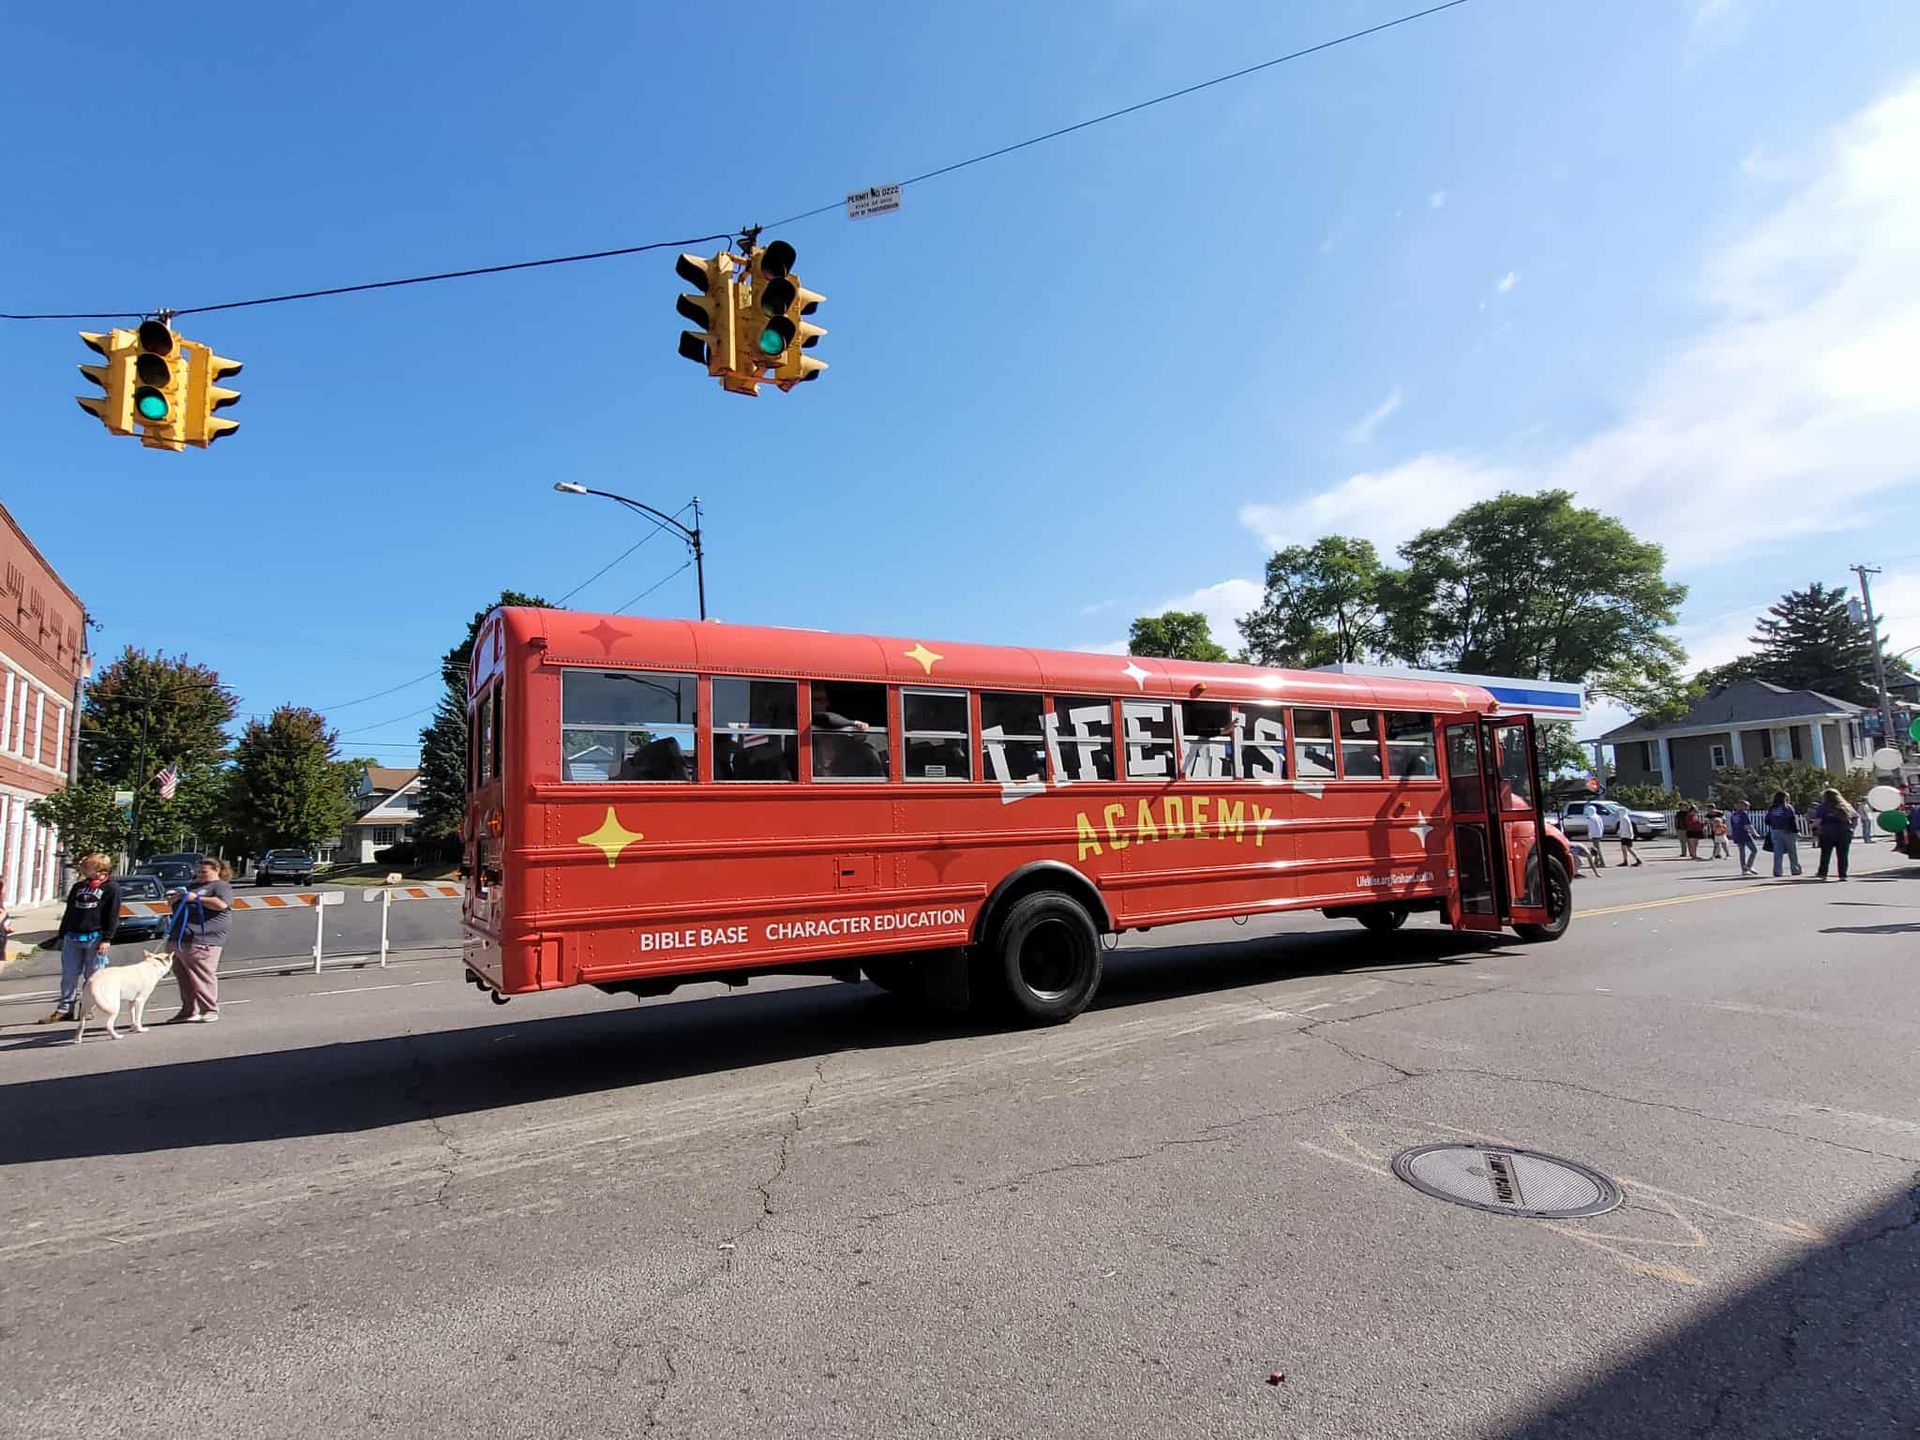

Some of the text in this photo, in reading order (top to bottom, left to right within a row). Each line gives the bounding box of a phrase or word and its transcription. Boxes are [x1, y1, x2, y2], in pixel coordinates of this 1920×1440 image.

[847, 192, 869, 203] PERMIT
[882, 185, 899, 196] 0222
[1076, 795, 1273, 862] ACADEMY
[640, 908, 966, 951] BIBLE BASE CHARACTER EDUCATION
